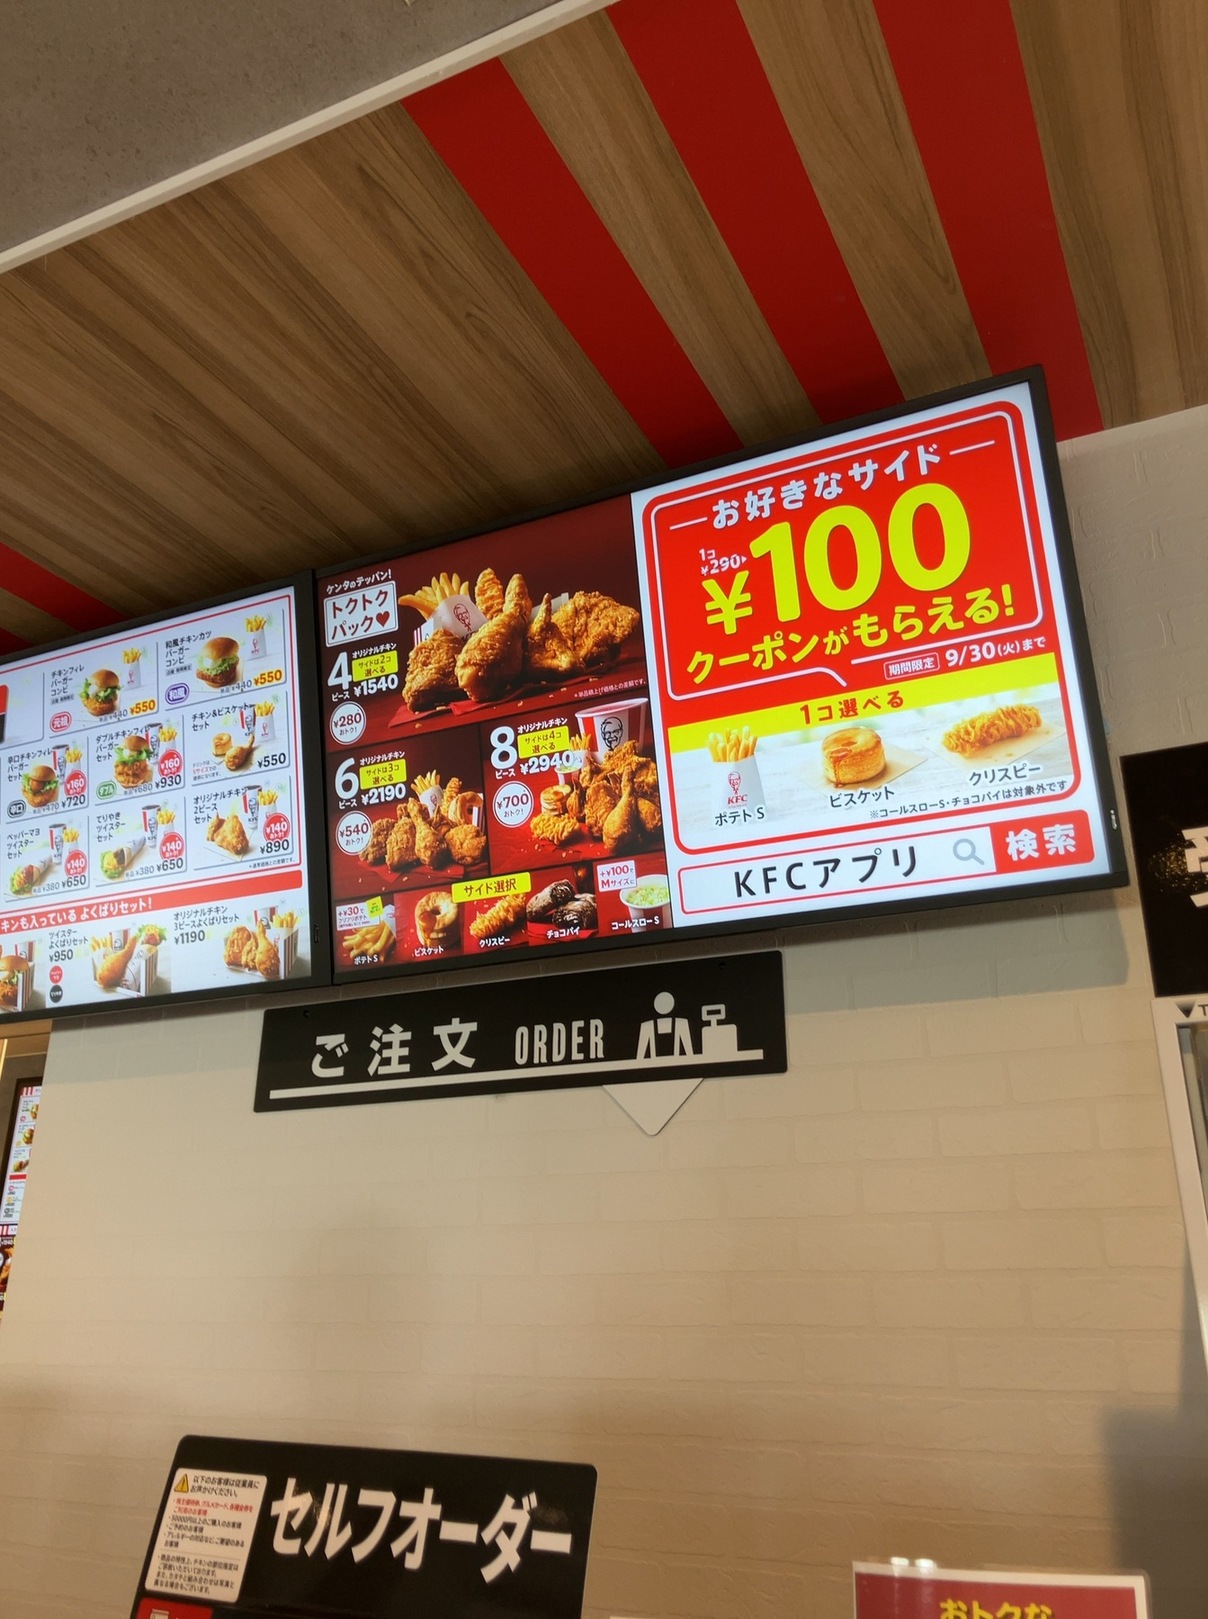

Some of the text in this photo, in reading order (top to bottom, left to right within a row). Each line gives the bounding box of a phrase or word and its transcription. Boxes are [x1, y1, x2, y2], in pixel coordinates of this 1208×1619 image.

[712, 443, 941, 530] お好きなサイド
[702, 482, 971, 635] ¥100
[326, 568, 392, 595] ケンタのテッパン!
[332, 590, 388, 619] トクトク
[331, 615, 374, 640] パック
[686, 583, 1015, 684] クーポンがもらえる!
[165, 630, 212, 649] 和風チキンカツ
[165, 645, 190, 658] バーガー
[352, 642, 397, 659] オリジナルチキン
[889, 636, 1046, 676] 期間限定 9/30(火)まで
[358, 655, 392, 668] サイドは2コ
[51, 664, 85, 679] チキンフィレ
[254, 669, 283, 687] ¥550
[327, 651, 352, 690] 4
[364, 666, 386, 677] 選べる
[50, 677, 73, 688] バーガー
[353, 674, 399, 697] ¥1540
[331, 690, 350, 702] ピース
[130, 699, 156, 715] ¥550
[800, 690, 904, 725] 1コ選べる
[192, 721, 210, 732] セット
[333, 712, 362, 728] ¥280
[517, 717, 568, 734] オリジナルチキン
[524, 730, 562, 744] サイドは4コ
[96, 742, 119, 753] バーガー
[490, 726, 518, 770] 8
[532, 742, 556, 754] 選べる
[96, 752, 113, 763] セット
[160, 757, 180, 770] ¥160
[257, 752, 286, 768] ¥550
[360, 750, 406, 766] オリジナルチキン
[520, 751, 574, 775] ¥2940
[7, 763, 29, 773] バーガー
[366, 763, 400, 776] サイドは3コ
[495, 768, 516, 780] ピース
[969, 762, 1041, 786] クリスピー
[66, 777, 85, 790] ¥160
[155, 774, 182, 789] ¥930
[335, 757, 359, 800] 6
[372, 774, 394, 785] 選べる
[62, 794, 86, 808] ¥720
[193, 787, 248, 805] オリジナルチキン
[361, 783, 406, 805] ¥2190
[496, 793, 529, 810] ¥700
[727, 793, 748, 805] KFC
[829, 785, 895, 808] ビスケット
[339, 798, 358, 810] ピース
[194, 814, 212, 824] セット
[503, 808, 524, 818] おトク!
[715, 807, 765, 827] ポテト S
[265, 821, 288, 834] ¥140
[339, 822, 369, 838] ¥540
[96, 832, 113, 843] セット
[1005, 823, 1076, 862] 検索
[162, 841, 182, 852] ¥140
[260, 839, 290, 854] ¥890
[67, 858, 86, 870] ¥140
[156, 857, 184, 872] ¥650
[734, 845, 917, 898] KFCアプリ
[61, 875, 87, 889] ¥650
[463, 878, 517, 897] サイド選択
[80, 897, 152, 920] よくばりセット!
[173, 905, 228, 921] オリジナルチキン
[611, 915, 660, 931] コールスロー S
[174, 929, 206, 945] ¥1190
[479, 936, 511, 948] クリスピー
[49, 949, 74, 963] ¥950
[414, 945, 444, 957] ビスケット
[354, 954, 378, 965] ポテト S
[311, 1017, 605, 1079] ご注文 ORDER
[270, 1476, 573, 1584] セルフオーダー
